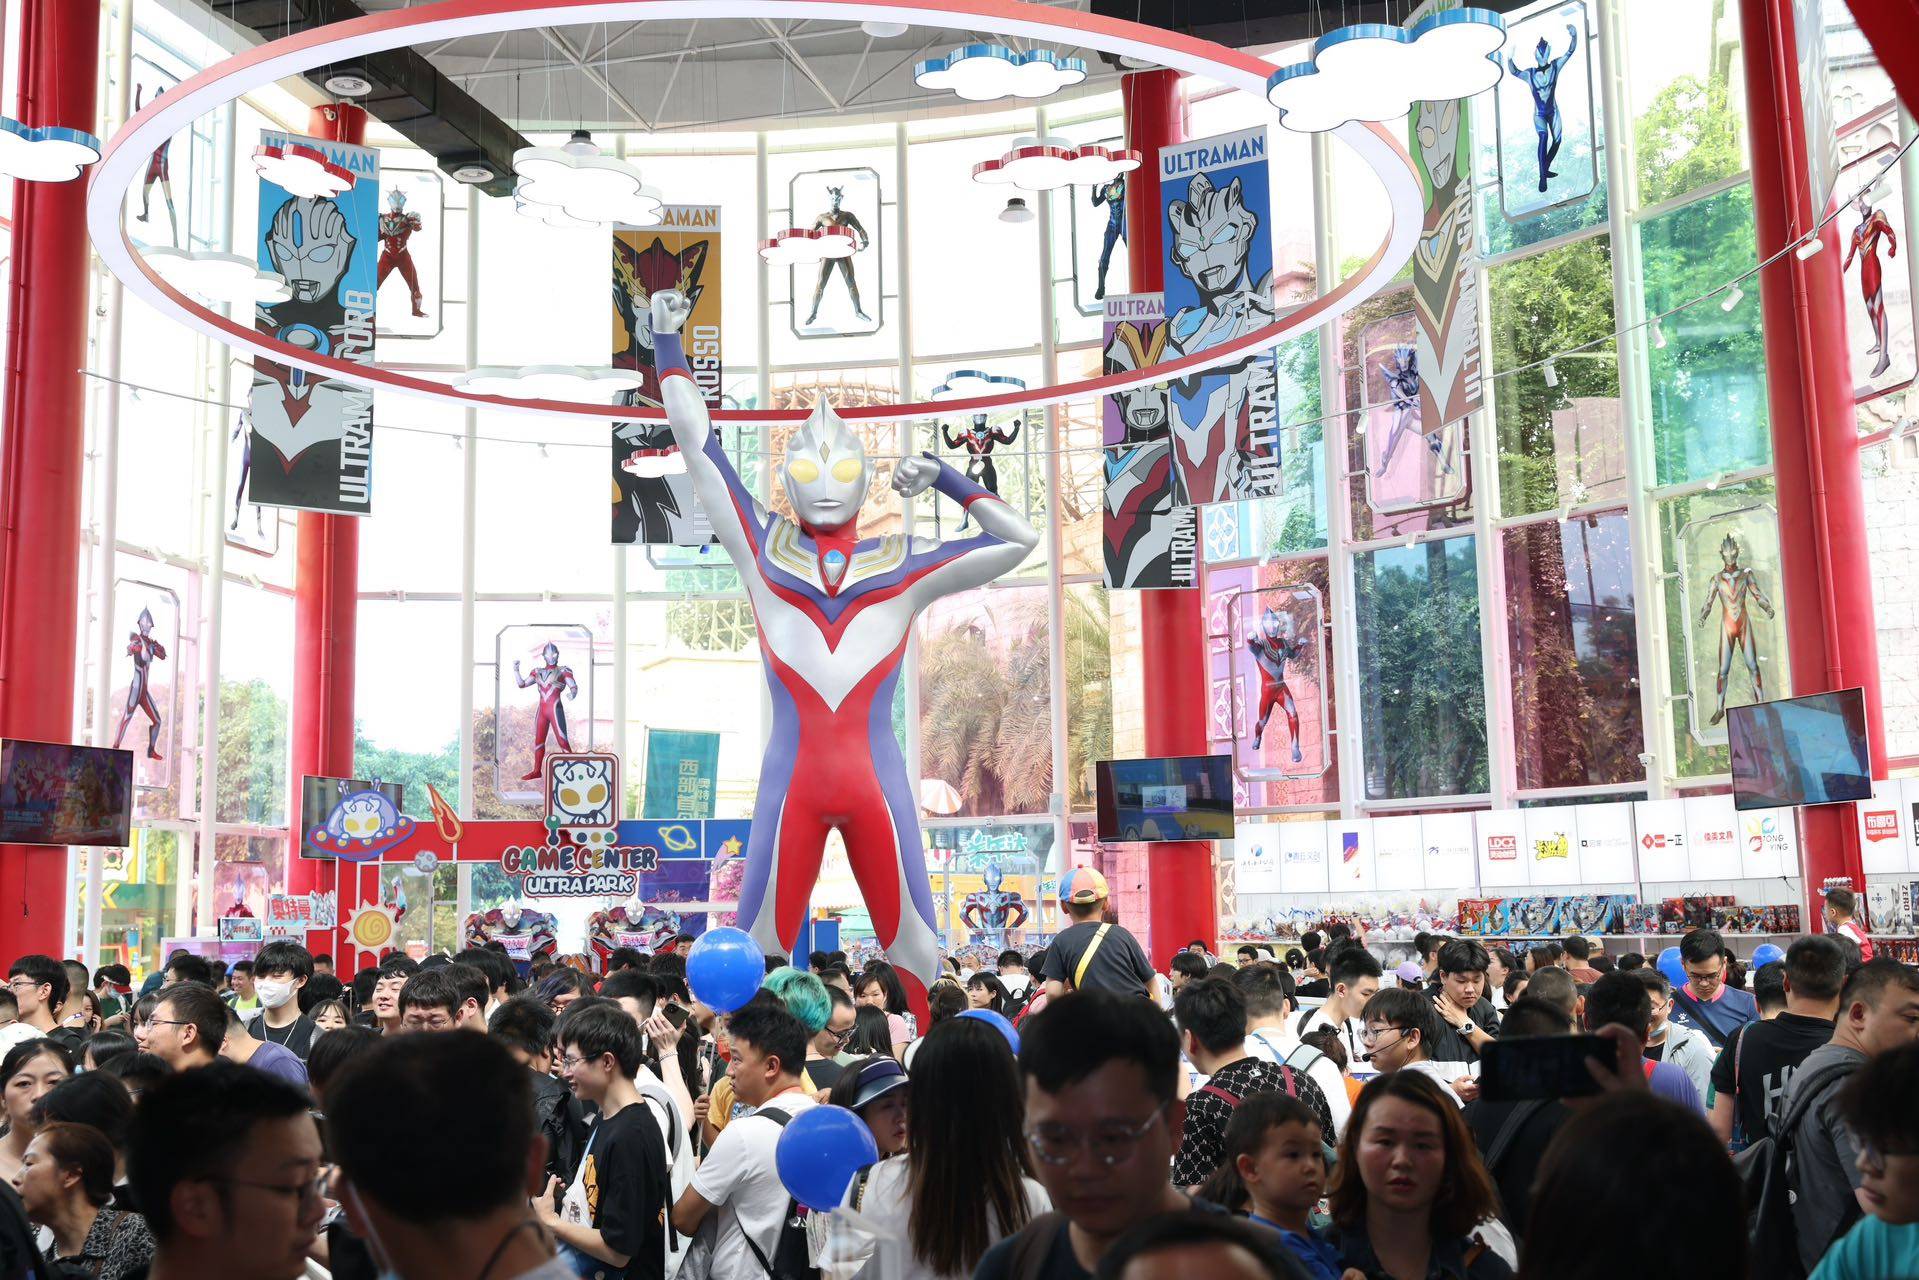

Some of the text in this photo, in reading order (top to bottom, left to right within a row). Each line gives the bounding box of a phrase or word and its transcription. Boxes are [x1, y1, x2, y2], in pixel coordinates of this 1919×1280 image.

[1164, 135, 1265, 176] ULTRAMAN
[661, 208, 717, 227] AMAN
[1454, 173, 1474, 247] GAIA
[1107, 298, 1165, 318] ULTRA
[692, 325, 720, 401] ROSSO
[340, 289, 375, 504] ULTRAMN ORB
[1171, 505, 1197, 581] ULTRAM
[503, 846, 657, 873] GAME CENTER
[1770, 843, 1789, 851] YING
[527, 875, 635, 894] ULTRA PARK
[1901, 885, 1911, 911] ZERO
